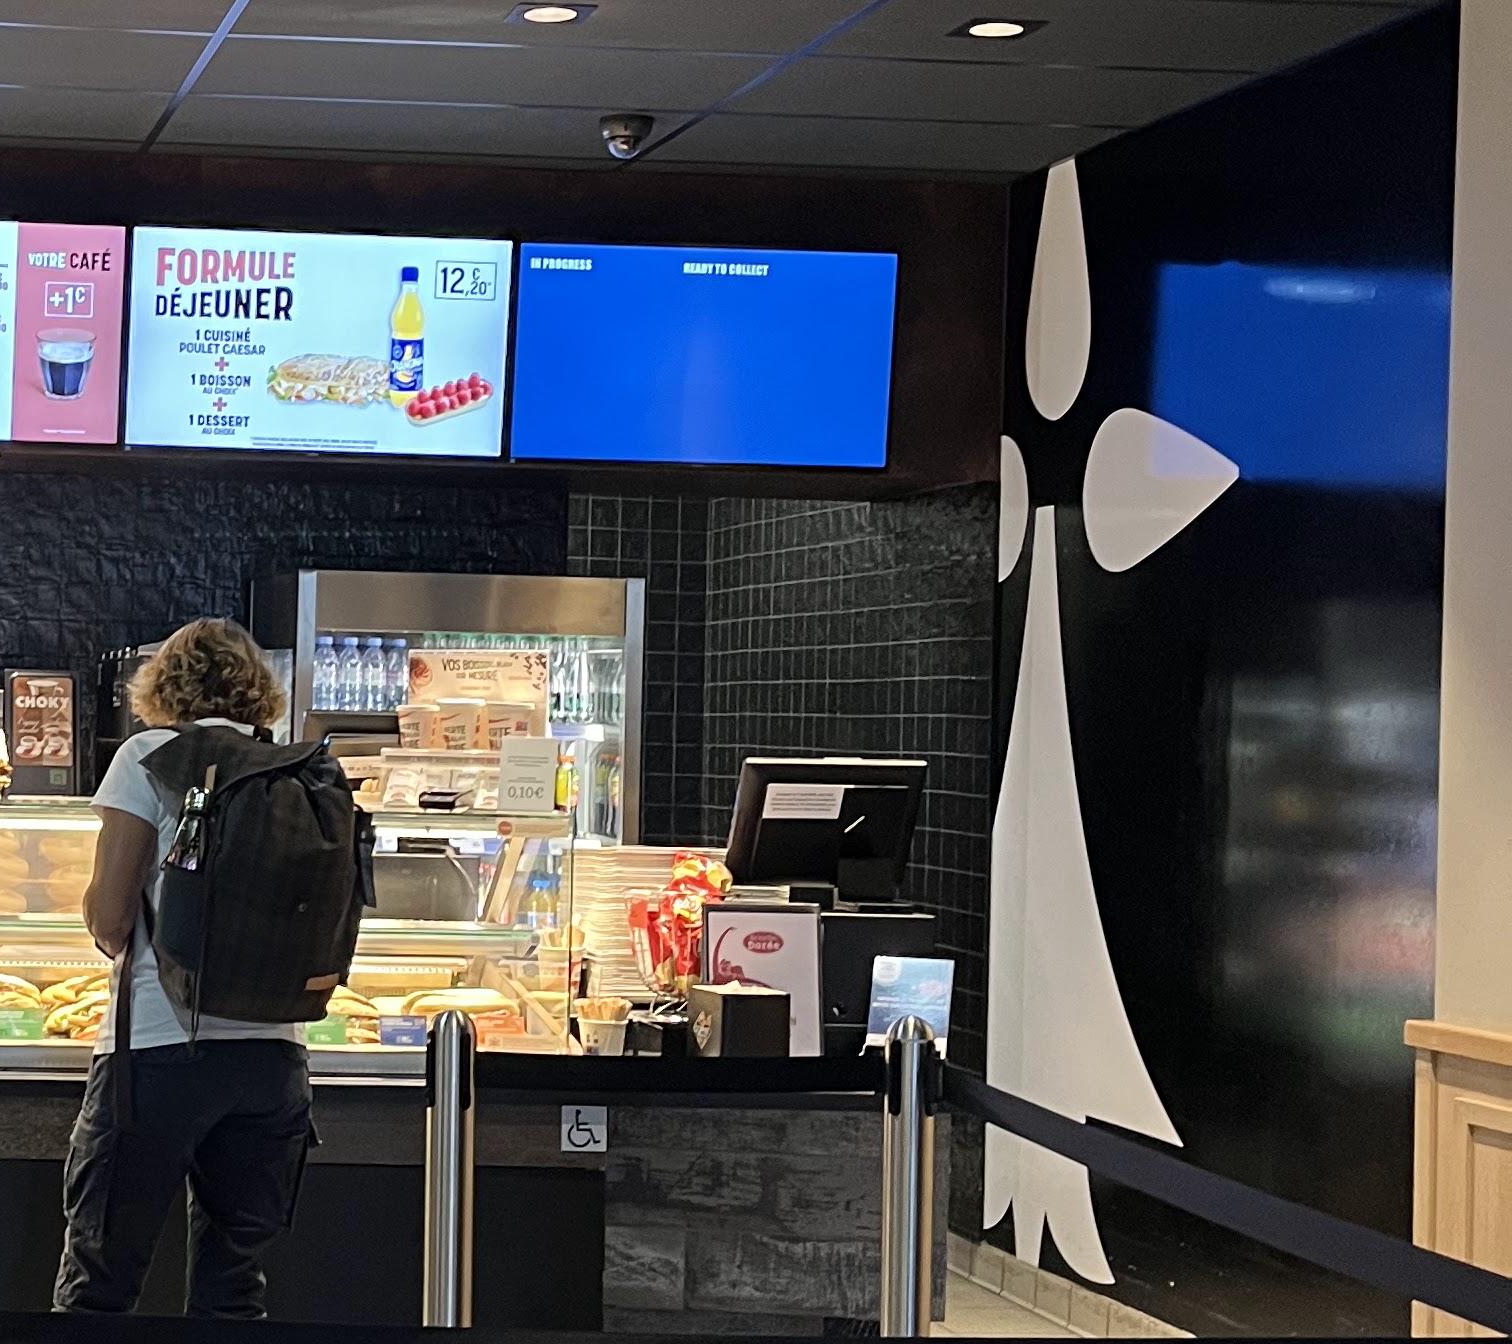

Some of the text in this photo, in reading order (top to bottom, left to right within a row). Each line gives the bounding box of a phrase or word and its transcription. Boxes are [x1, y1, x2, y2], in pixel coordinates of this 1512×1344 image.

[28, 248, 111, 271] VOTRE CAFÉ
[156, 247, 296, 286] FORMULE
[530, 257, 593, 271] IN PROGRESS
[683, 262, 769, 276] READY TO COLLECT
[155, 286, 293, 322] DÉJEUNER
[195, 328, 251, 342] 1 CUISINÉ
[179, 342, 266, 356] POULET CAESAR
[190, 374, 251, 387] 1 BOISSON
[189, 414, 250, 427] 1 DESSERT
[15, 696, 70, 709] CHOKY
[508, 785, 545, 800] 0,10€
